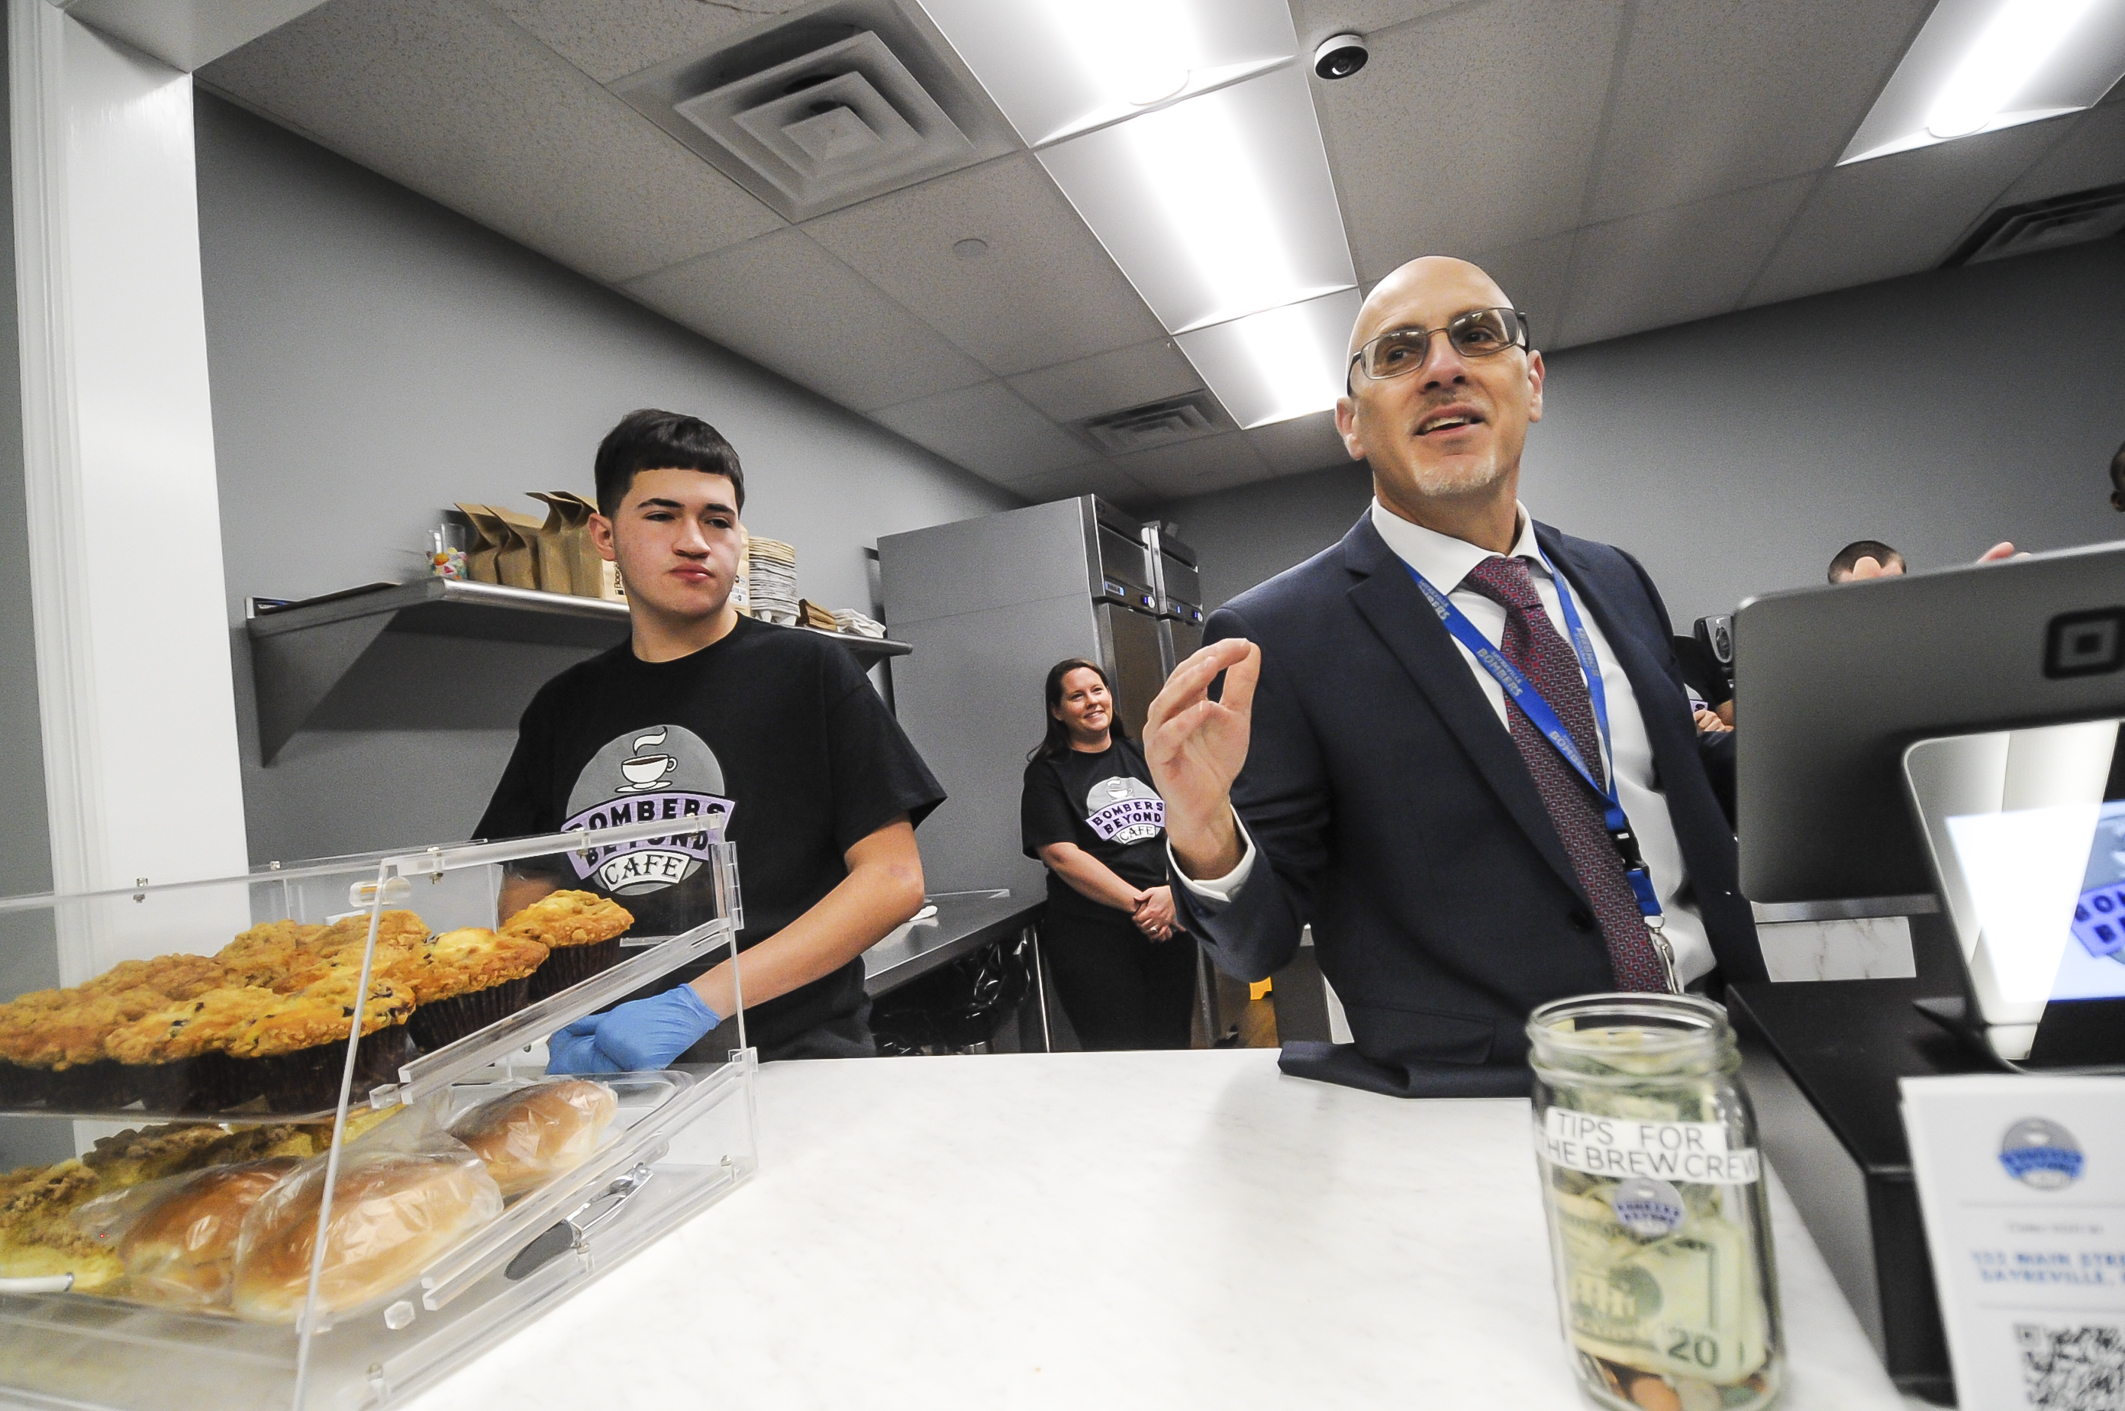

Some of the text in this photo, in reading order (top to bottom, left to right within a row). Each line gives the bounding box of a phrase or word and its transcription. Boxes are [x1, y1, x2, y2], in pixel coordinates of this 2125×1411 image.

[1477, 647, 1524, 697] BOMBERS
[1091, 801, 1164, 826] BOMBERS
[1103, 811, 1162, 835] BEYOND
[1119, 825, 1154, 841] CAFE
[604, 853, 684, 885] CAFE
[1557, 1112, 1706, 1152] TIPS FOR
[1585, 1145, 1679, 1176] BREW
[2016, 1251, 2071, 1266] MAIN
[1667, 1325, 1721, 1369] 20
